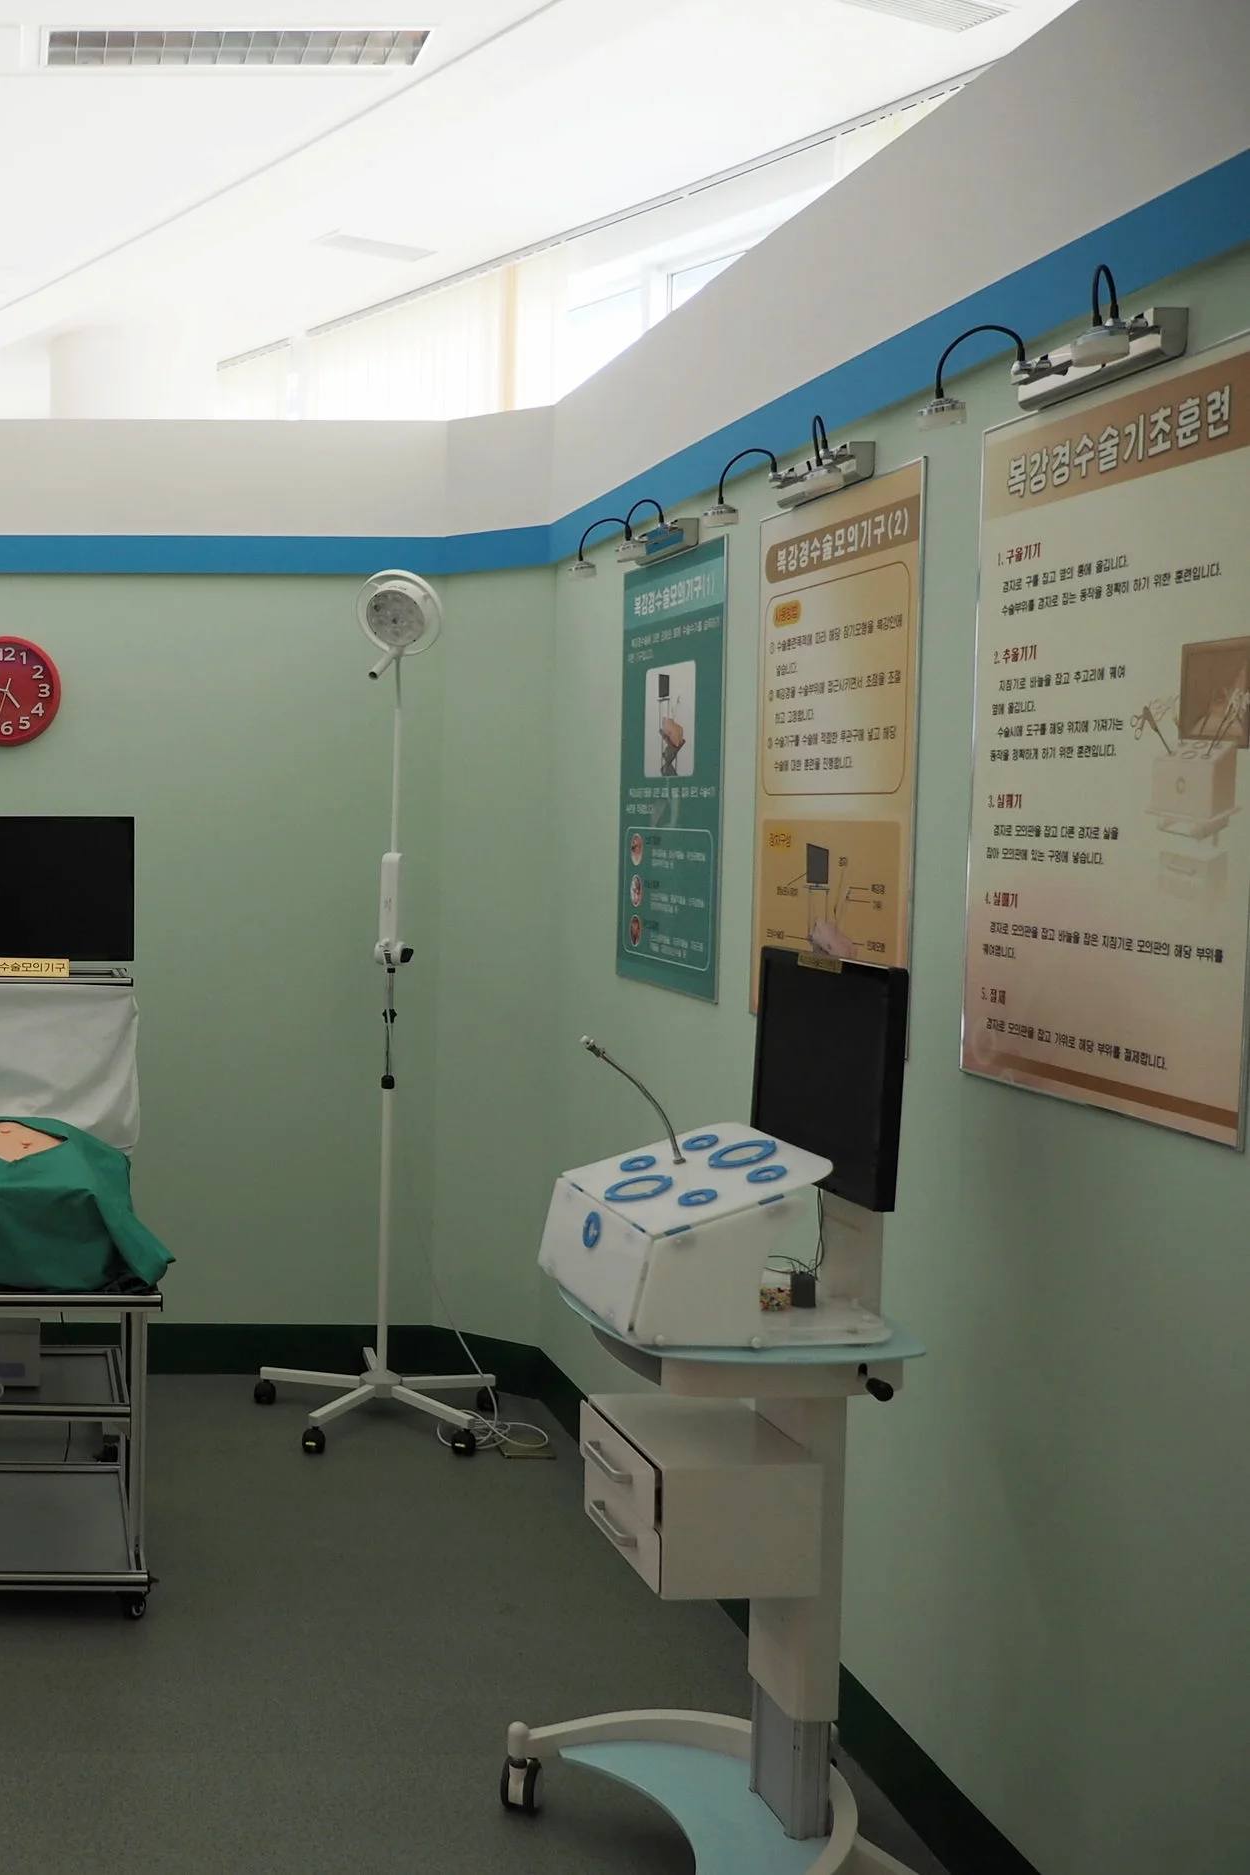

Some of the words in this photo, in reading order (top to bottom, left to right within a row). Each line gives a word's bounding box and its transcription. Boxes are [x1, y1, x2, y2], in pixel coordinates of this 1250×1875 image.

[1007, 384, 1231, 497] 복강경수술기초훈련
[776, 507, 909, 574] 복강경수술모의기구(2)
[633, 571, 715, 617] 복강경수술모의기구(1)
[20, 652, 27, 664] 1
[32, 665, 44, 679] 2
[38, 684, 50, 697] 3
[31, 703, 44, 716] 4
[1, 721, 13, 735] 6
[19, 717, 30, 730] 5
